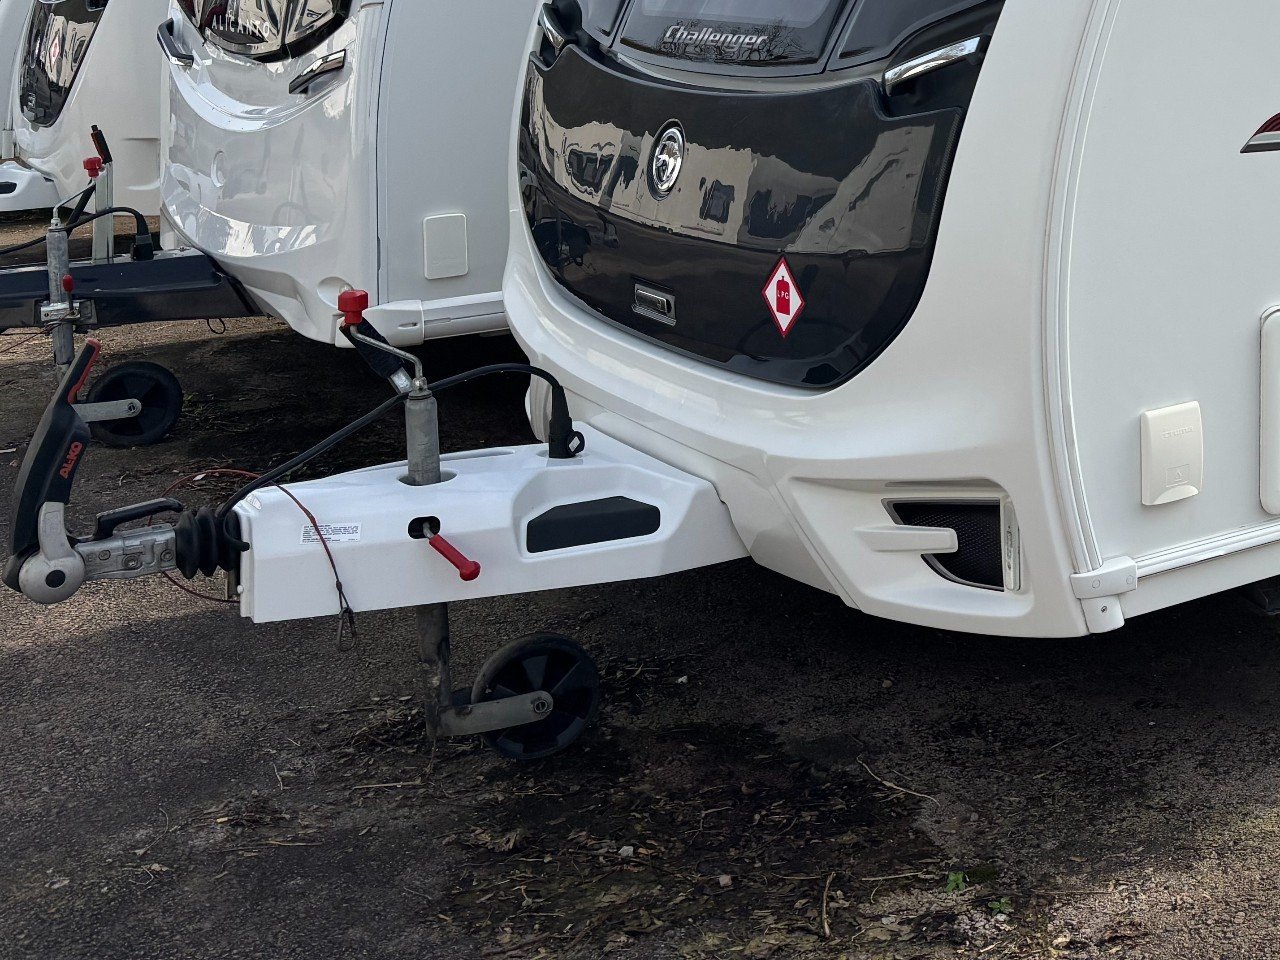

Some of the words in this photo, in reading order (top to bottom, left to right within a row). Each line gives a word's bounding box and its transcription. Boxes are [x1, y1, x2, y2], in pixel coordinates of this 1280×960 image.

[212, 14, 269, 38] ALICANTO
[663, 25, 769, 52] Challenger
[777, 290, 789, 300] LPG
